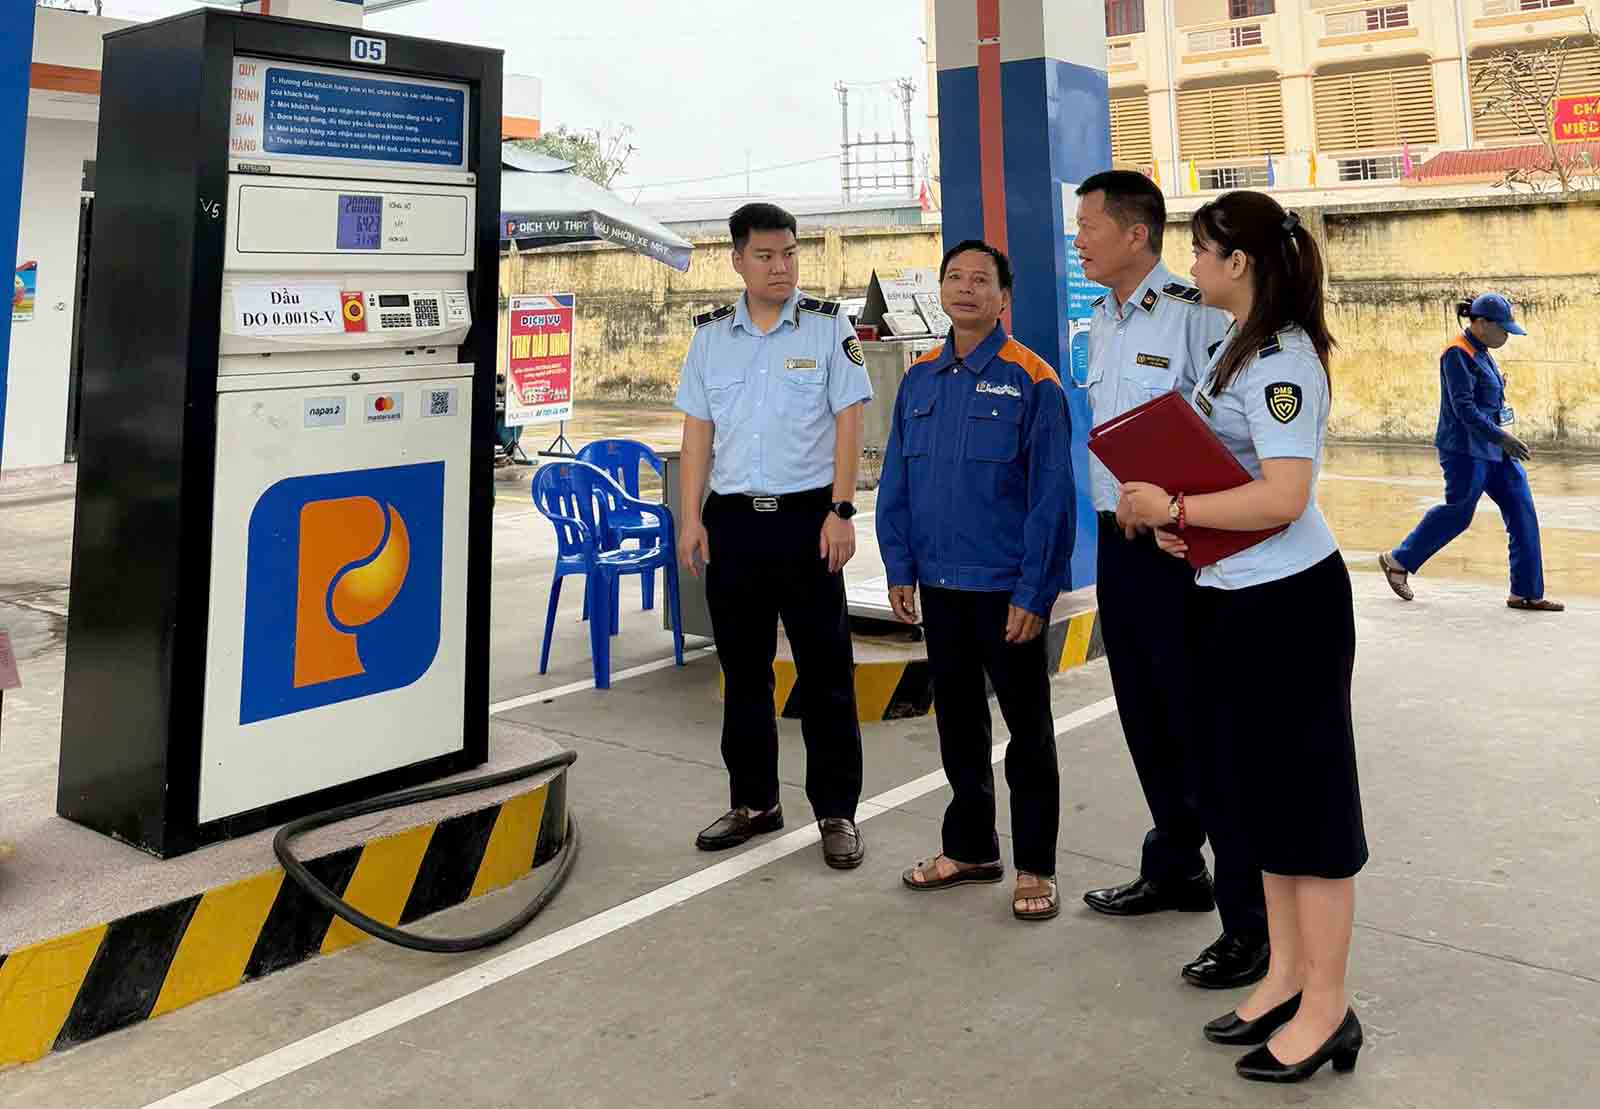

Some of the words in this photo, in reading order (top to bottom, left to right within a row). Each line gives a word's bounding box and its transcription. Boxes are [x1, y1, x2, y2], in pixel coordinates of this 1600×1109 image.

[354, 39, 382, 60] 05
[271, 287, 300, 305] Dầu
[242, 312, 268, 327] DO
[272, 310, 336, 326] 0.001S-V
[521, 315, 545, 328] DỊCH
[1273, 386, 1293, 395] DMS
